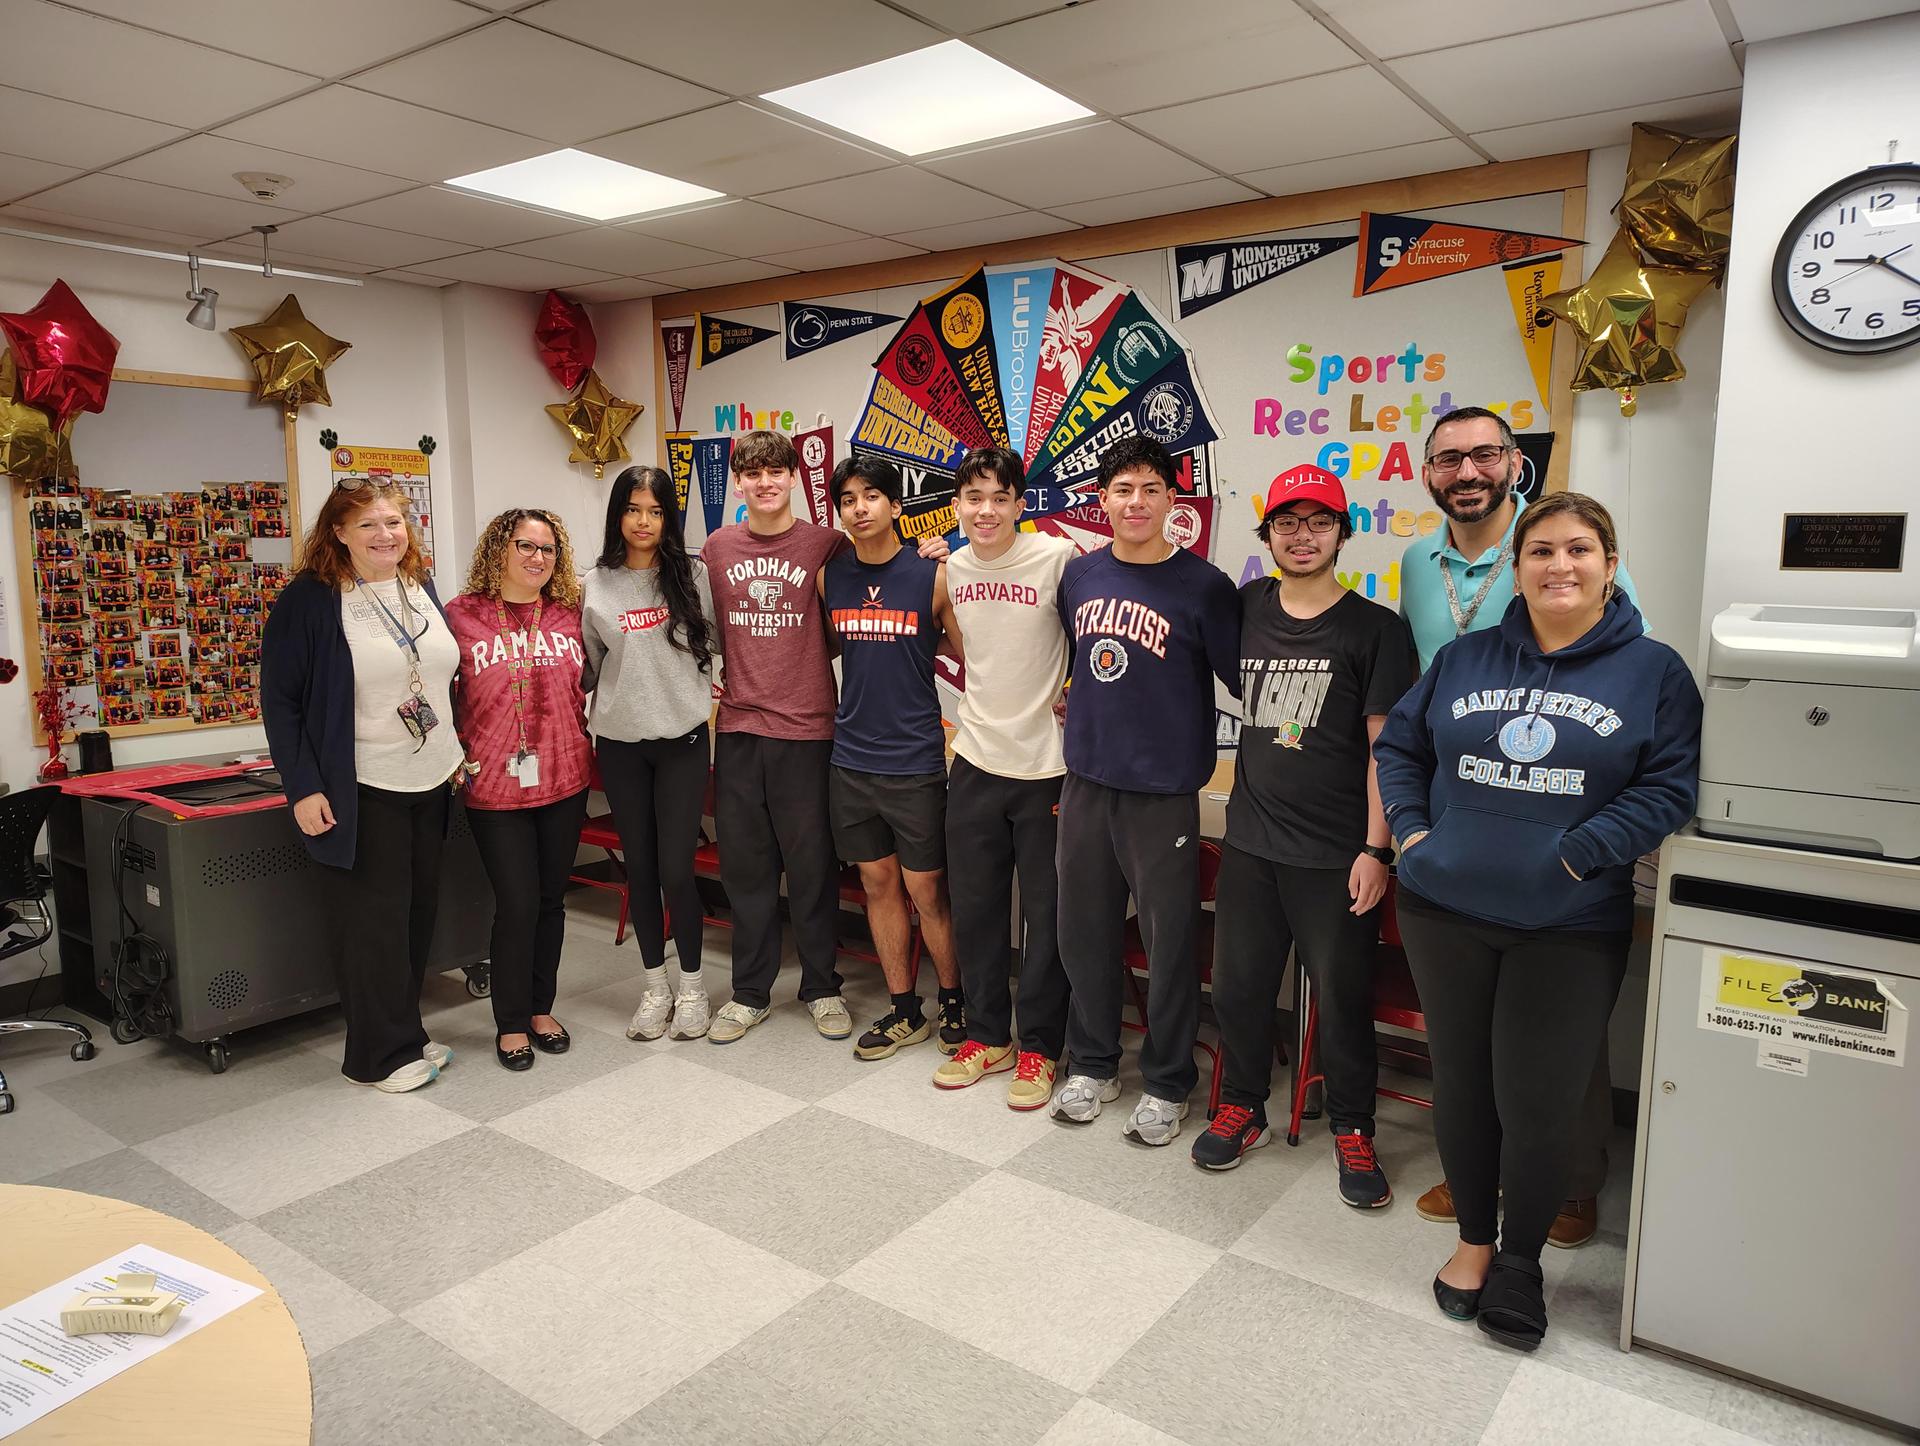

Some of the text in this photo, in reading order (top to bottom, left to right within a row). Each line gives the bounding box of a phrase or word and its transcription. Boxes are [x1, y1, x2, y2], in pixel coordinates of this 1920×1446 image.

[1839, 206, 1856, 225] 11
[1869, 193, 1896, 212] 12
[1379, 236, 1402, 268] S
[1408, 236, 1465, 252] Syracuse
[1813, 231, 1835, 250] 10
[1231, 242, 1321, 269] MONMOUTH
[1231, 248, 1321, 290] UNIVERSITY
[1406, 251, 1471, 267] University
[1801, 261, 1821, 278] 9
[1180, 252, 1227, 302] M
[1810, 287, 1831, 305] 8
[1901, 300, 1920, 317] 5
[830, 315, 873, 328] PENN STATE
[1523, 285, 1536, 340] University
[1834, 306, 1852, 324] 7
[1865, 312, 1884, 329] 6
[668, 359, 678, 382] LATINO
[958, 353, 983, 394] NEW
[1085, 354, 1101, 382] NEW
[1286, 341, 1447, 396] Sports
[926, 366, 958, 404] EAST
[974, 345, 1004, 429] UNIVERSITY
[714, 402, 794, 433] Where
[873, 375, 960, 450] GEORGIAN COURT
[1043, 391, 1067, 425] BALL
[1047, 361, 1130, 458] NJCU
[1253, 391, 1534, 438] Rec Letts
[858, 404, 956, 464] UNIVERSITY
[1025, 384, 1052, 468] UNIVERSITY
[358, 451, 425, 463] NORTH BERGEN
[359, 460, 424, 469] SCHOOL DISTRICT
[1316, 441, 1415, 482] GPA
[1192, 460, 1201, 484] THE
[725, 556, 808, 589] FORDHAM
[739, 600, 792, 611] 18 41
[955, 582, 1038, 607] HARVARD
[729, 611, 804, 628] UNIVERSITY
[751, 627, 778, 637] RAMS
[831, 608, 919, 636] VIRGINIA
[1075, 598, 1171, 660] SYRACUSE
[470, 629, 584, 677] RAMAPO
[1267, 658, 1331, 671] BERGEN
[1451, 687, 1623, 738] SAINT PETER'S
[1808, 706, 1827, 726] hp
[1457, 754, 1586, 796] COLLEGE
[1723, 976, 1884, 1014] FILE BANK
[1706, 1013, 1896, 1058] 1-800-625-7163 www.filebankinc.com
[1715, 1006, 1740, 1015] RECORD
[1742, 1011, 1771, 1022] STORAGE
[1788, 1019, 1836, 1033] INFORMATION
[1838, 1028, 1887, 1042] MANAGEMENT
